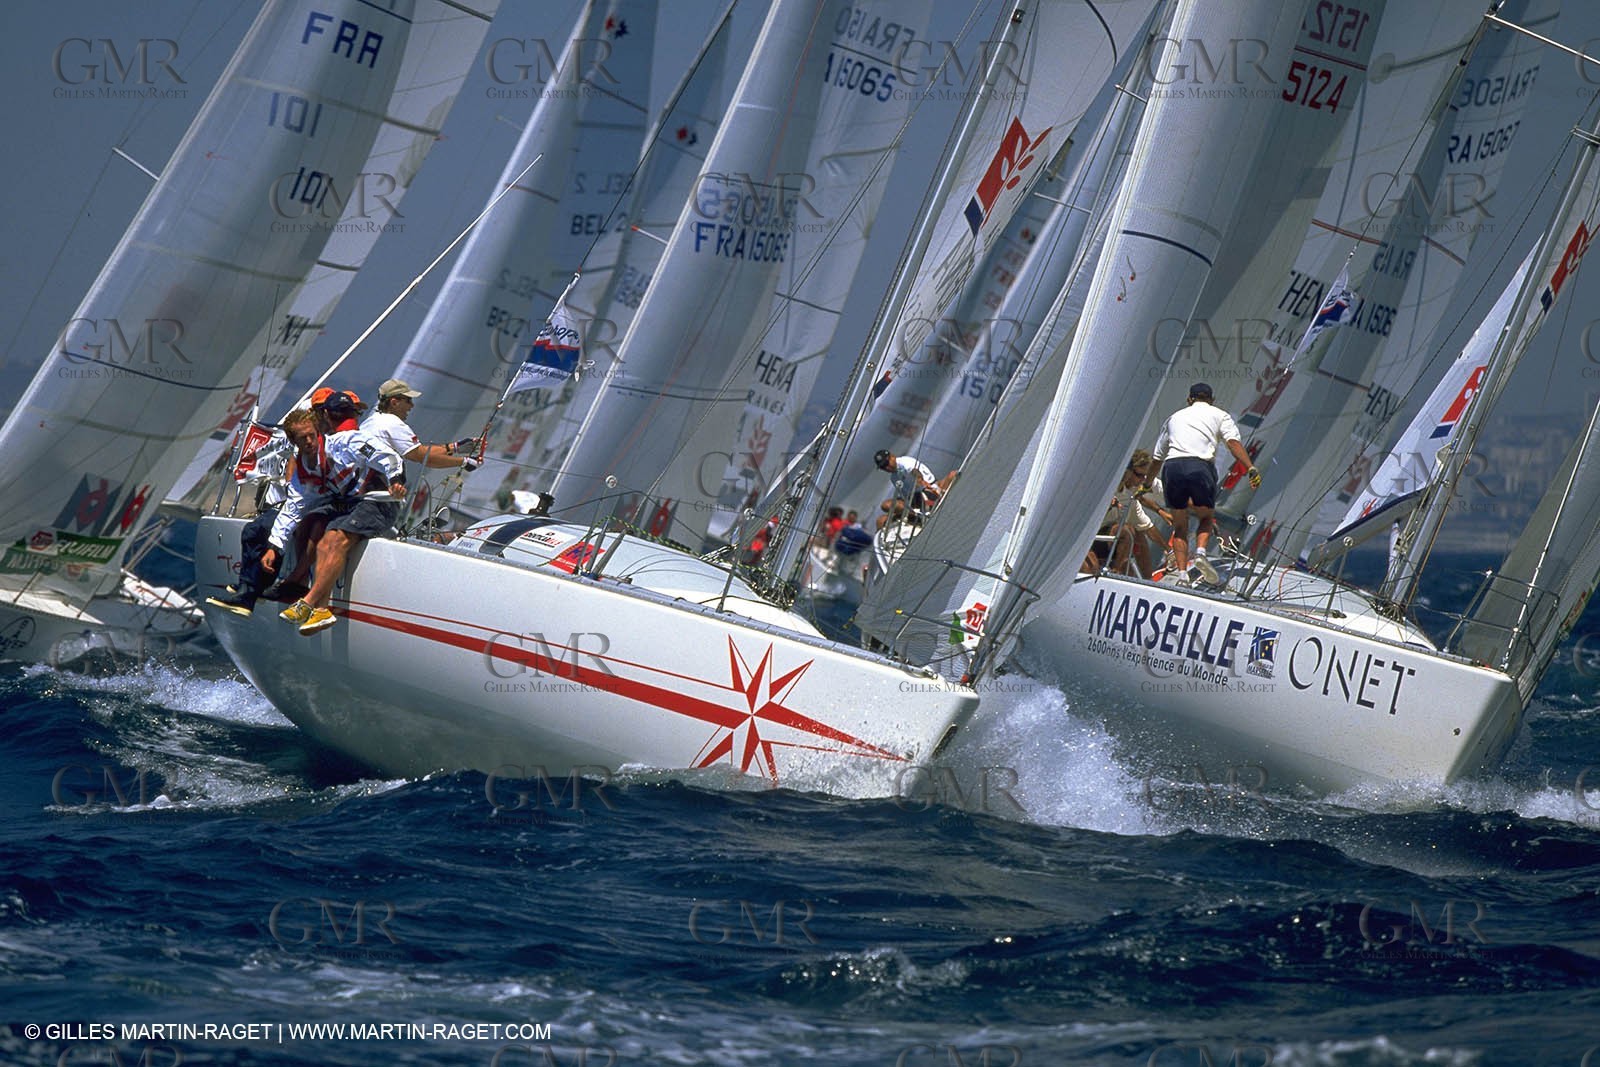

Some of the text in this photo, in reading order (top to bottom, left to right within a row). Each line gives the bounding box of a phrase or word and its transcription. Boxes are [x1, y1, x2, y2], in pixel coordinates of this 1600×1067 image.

[302, 12, 383, 69] FRA
[1282, 61, 1348, 114] 5124
[217, 554, 241, 575] Te
[1088, 589, 1245, 668] MARSEILLE
[1177, 661, 1191, 676] du
[1192, 665, 1228, 687] Monde
[1289, 636, 1416, 715] ONET
